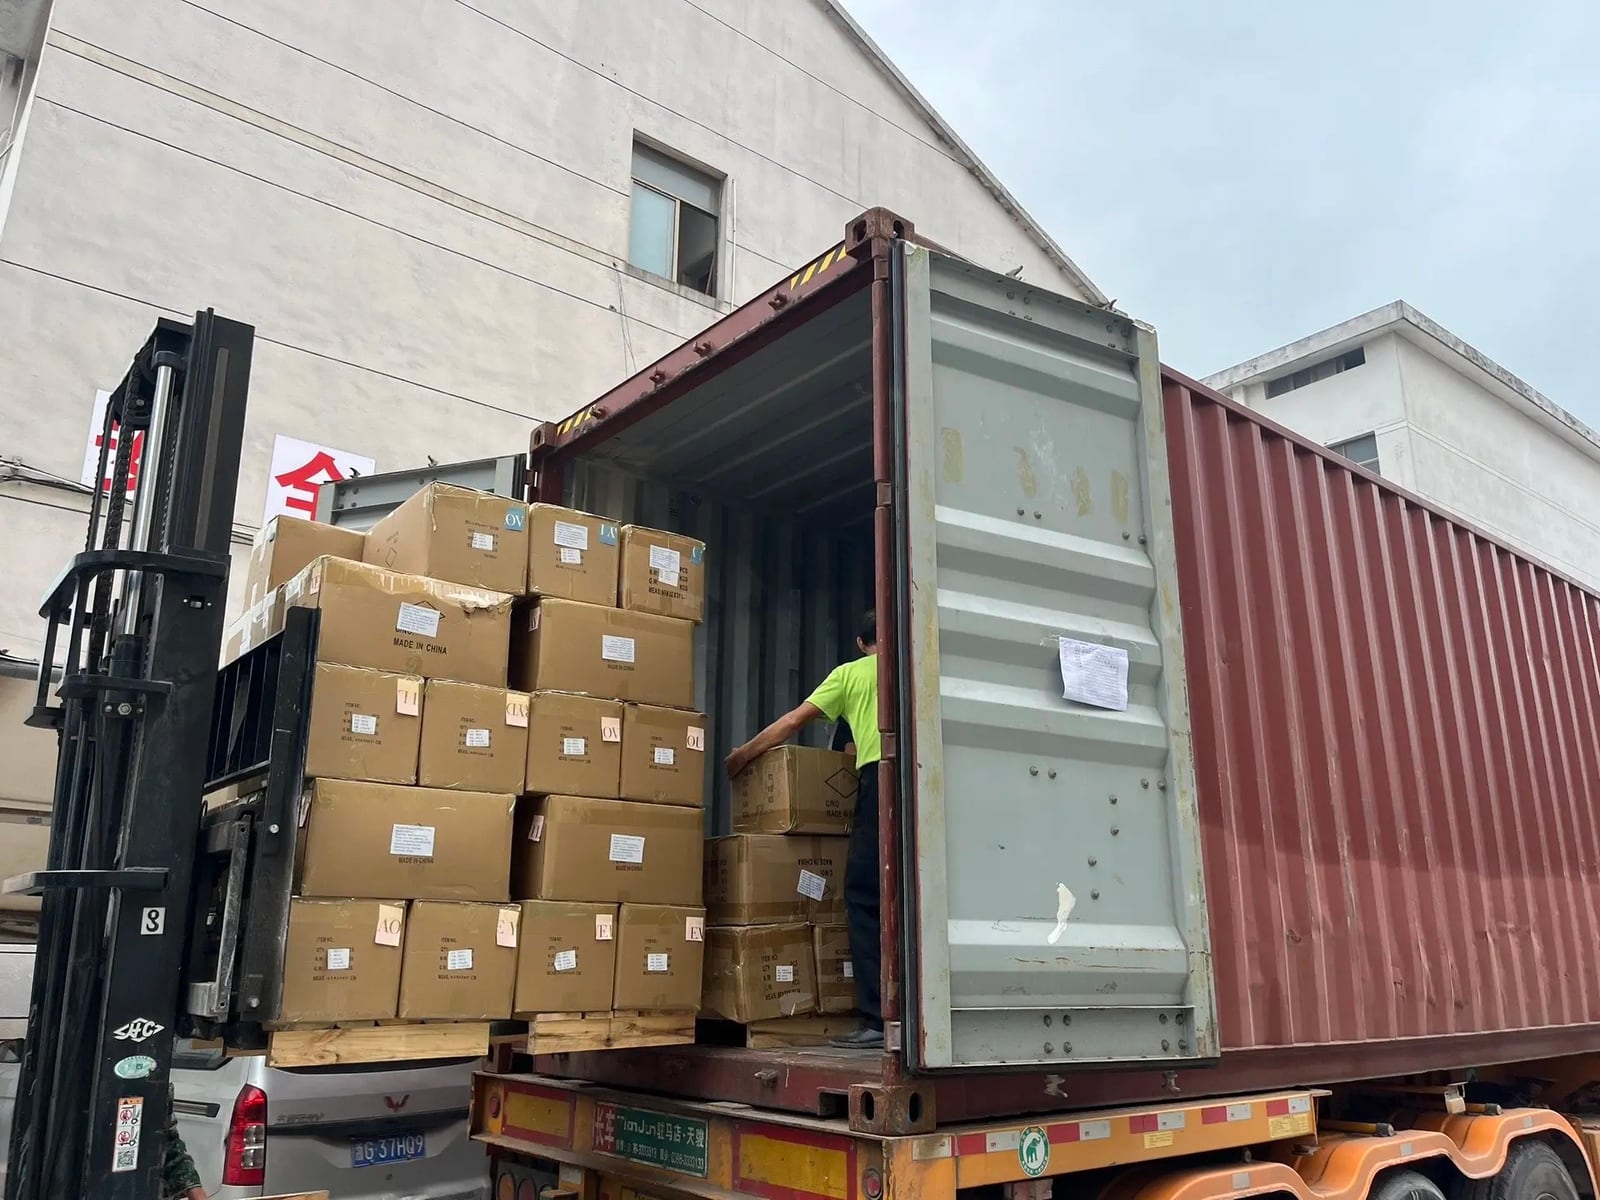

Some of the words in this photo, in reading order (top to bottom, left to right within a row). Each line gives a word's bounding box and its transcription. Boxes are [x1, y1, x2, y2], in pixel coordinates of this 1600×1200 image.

[393, 637, 414, 649] MADE
[416, 642, 424, 651] IN
[426, 644, 448, 655] CHINA
